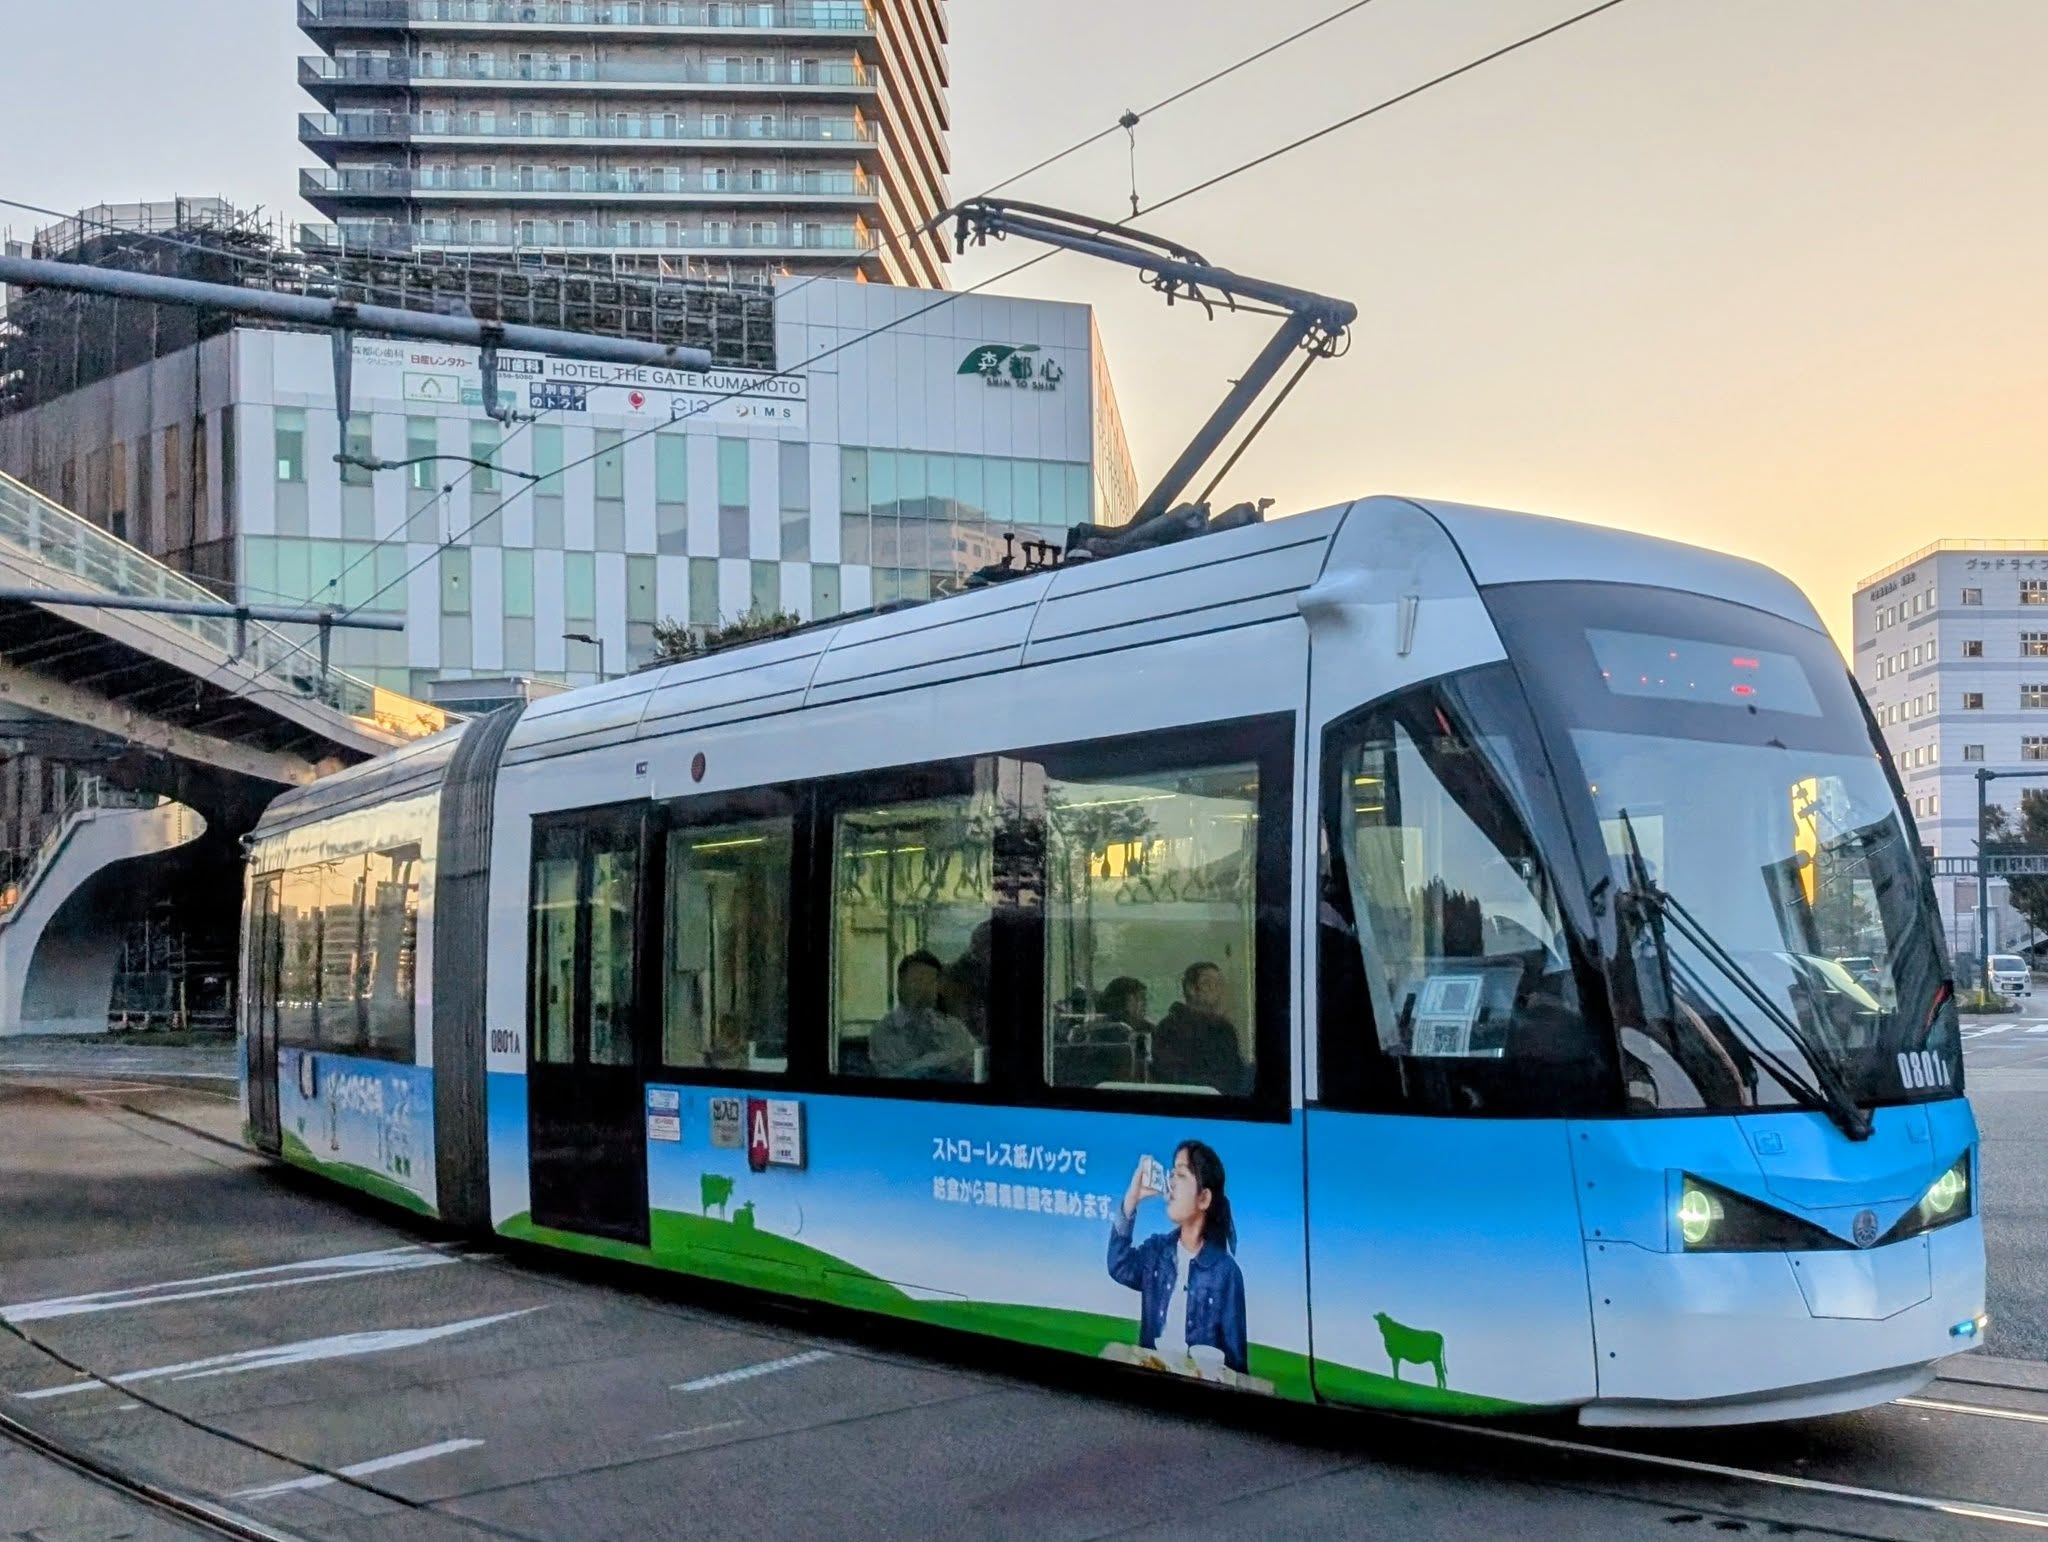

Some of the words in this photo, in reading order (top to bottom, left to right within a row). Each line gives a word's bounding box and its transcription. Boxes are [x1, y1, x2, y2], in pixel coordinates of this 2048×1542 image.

[410, 354, 473, 368] 日産レンタカー
[552, 363, 609, 379] HOTEL
[614, 367, 648, 382] THE
[652, 371, 697, 387] GATE
[702, 375, 801, 394] KUMAMOTO
[986, 377, 1011, 387] SHIN
[1015, 379, 1028, 388] TO
[1032, 381, 1056, 391] SHIN
[531, 399, 586, 410] のトライ
[753, 1110, 768, 1148] A
[932, 1137, 1087, 1175] ストローレス紙パックで
